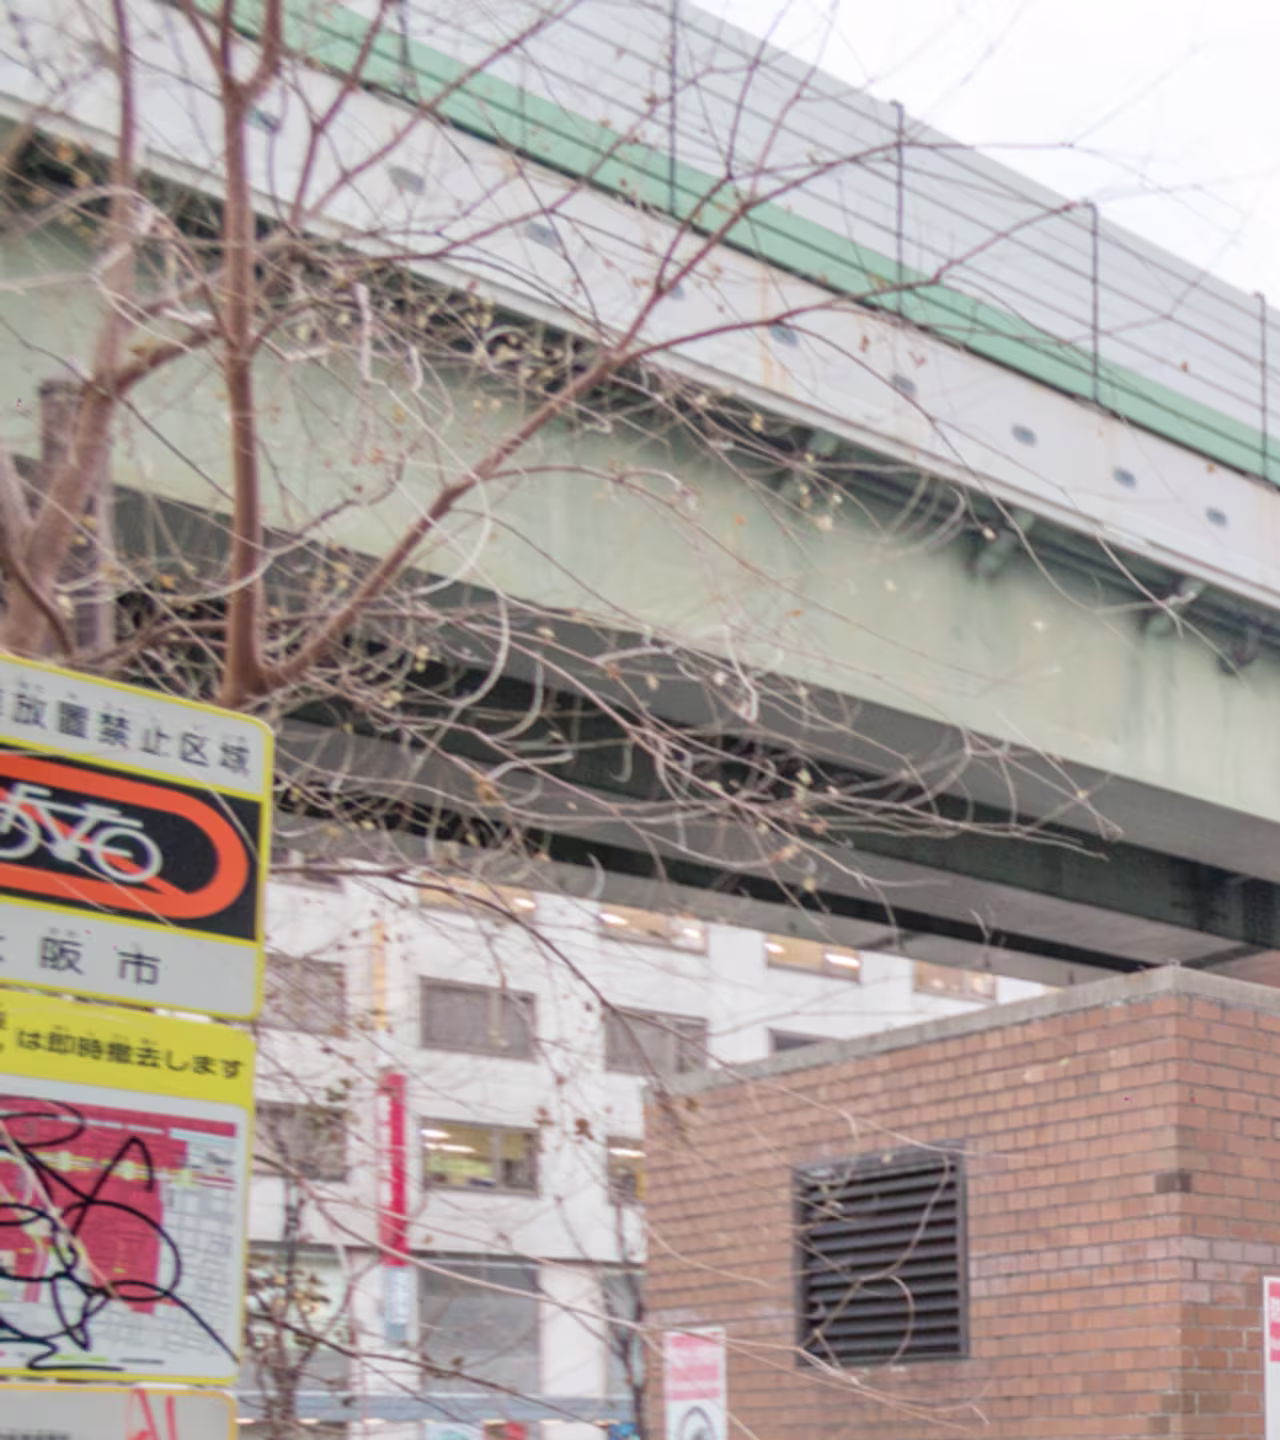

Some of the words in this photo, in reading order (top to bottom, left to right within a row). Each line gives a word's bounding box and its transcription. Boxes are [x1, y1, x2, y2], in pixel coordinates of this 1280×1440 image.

[0, 688, 251, 777] 放置禁止区域
[0, 935, 161, 986] 阪市
